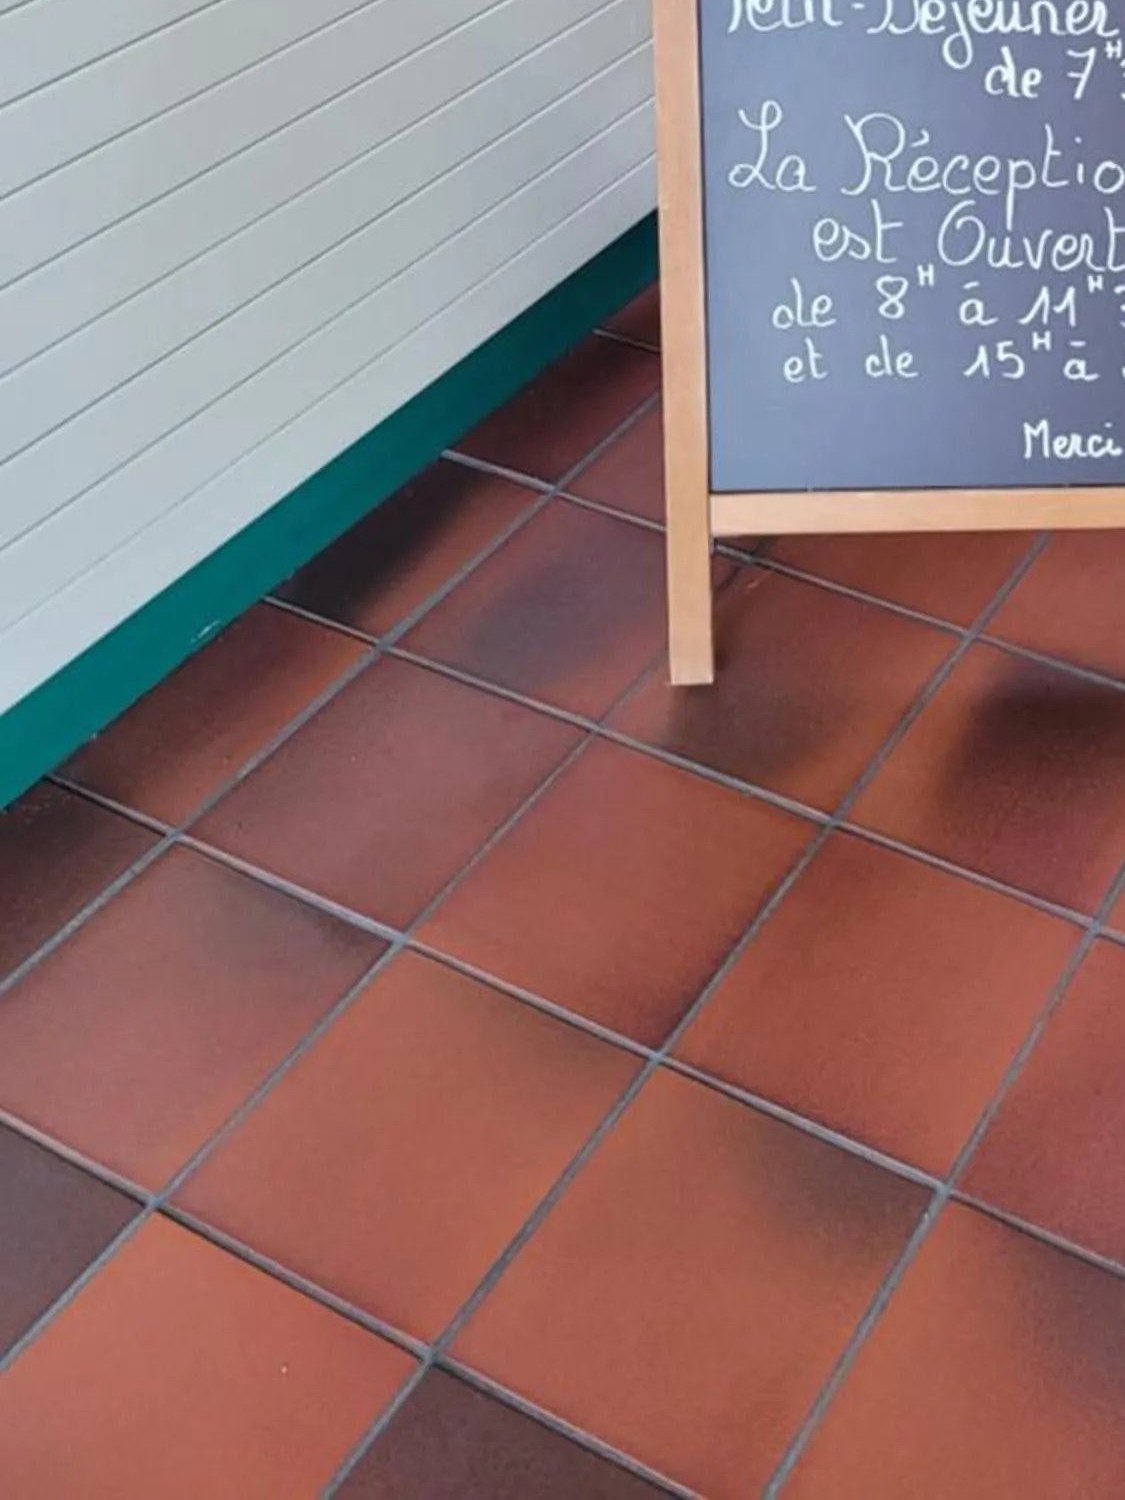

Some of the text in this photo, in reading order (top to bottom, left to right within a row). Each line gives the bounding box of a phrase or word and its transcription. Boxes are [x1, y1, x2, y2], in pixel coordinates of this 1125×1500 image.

[984, 45, 1043, 99] de
[728, 100, 817, 192] La
[813, 198, 904, 264] est
[772, 277, 836, 330] de
[783, 337, 829, 383] et
[865, 334, 919, 378] de
[1023, 418, 1124, 460] Merci
